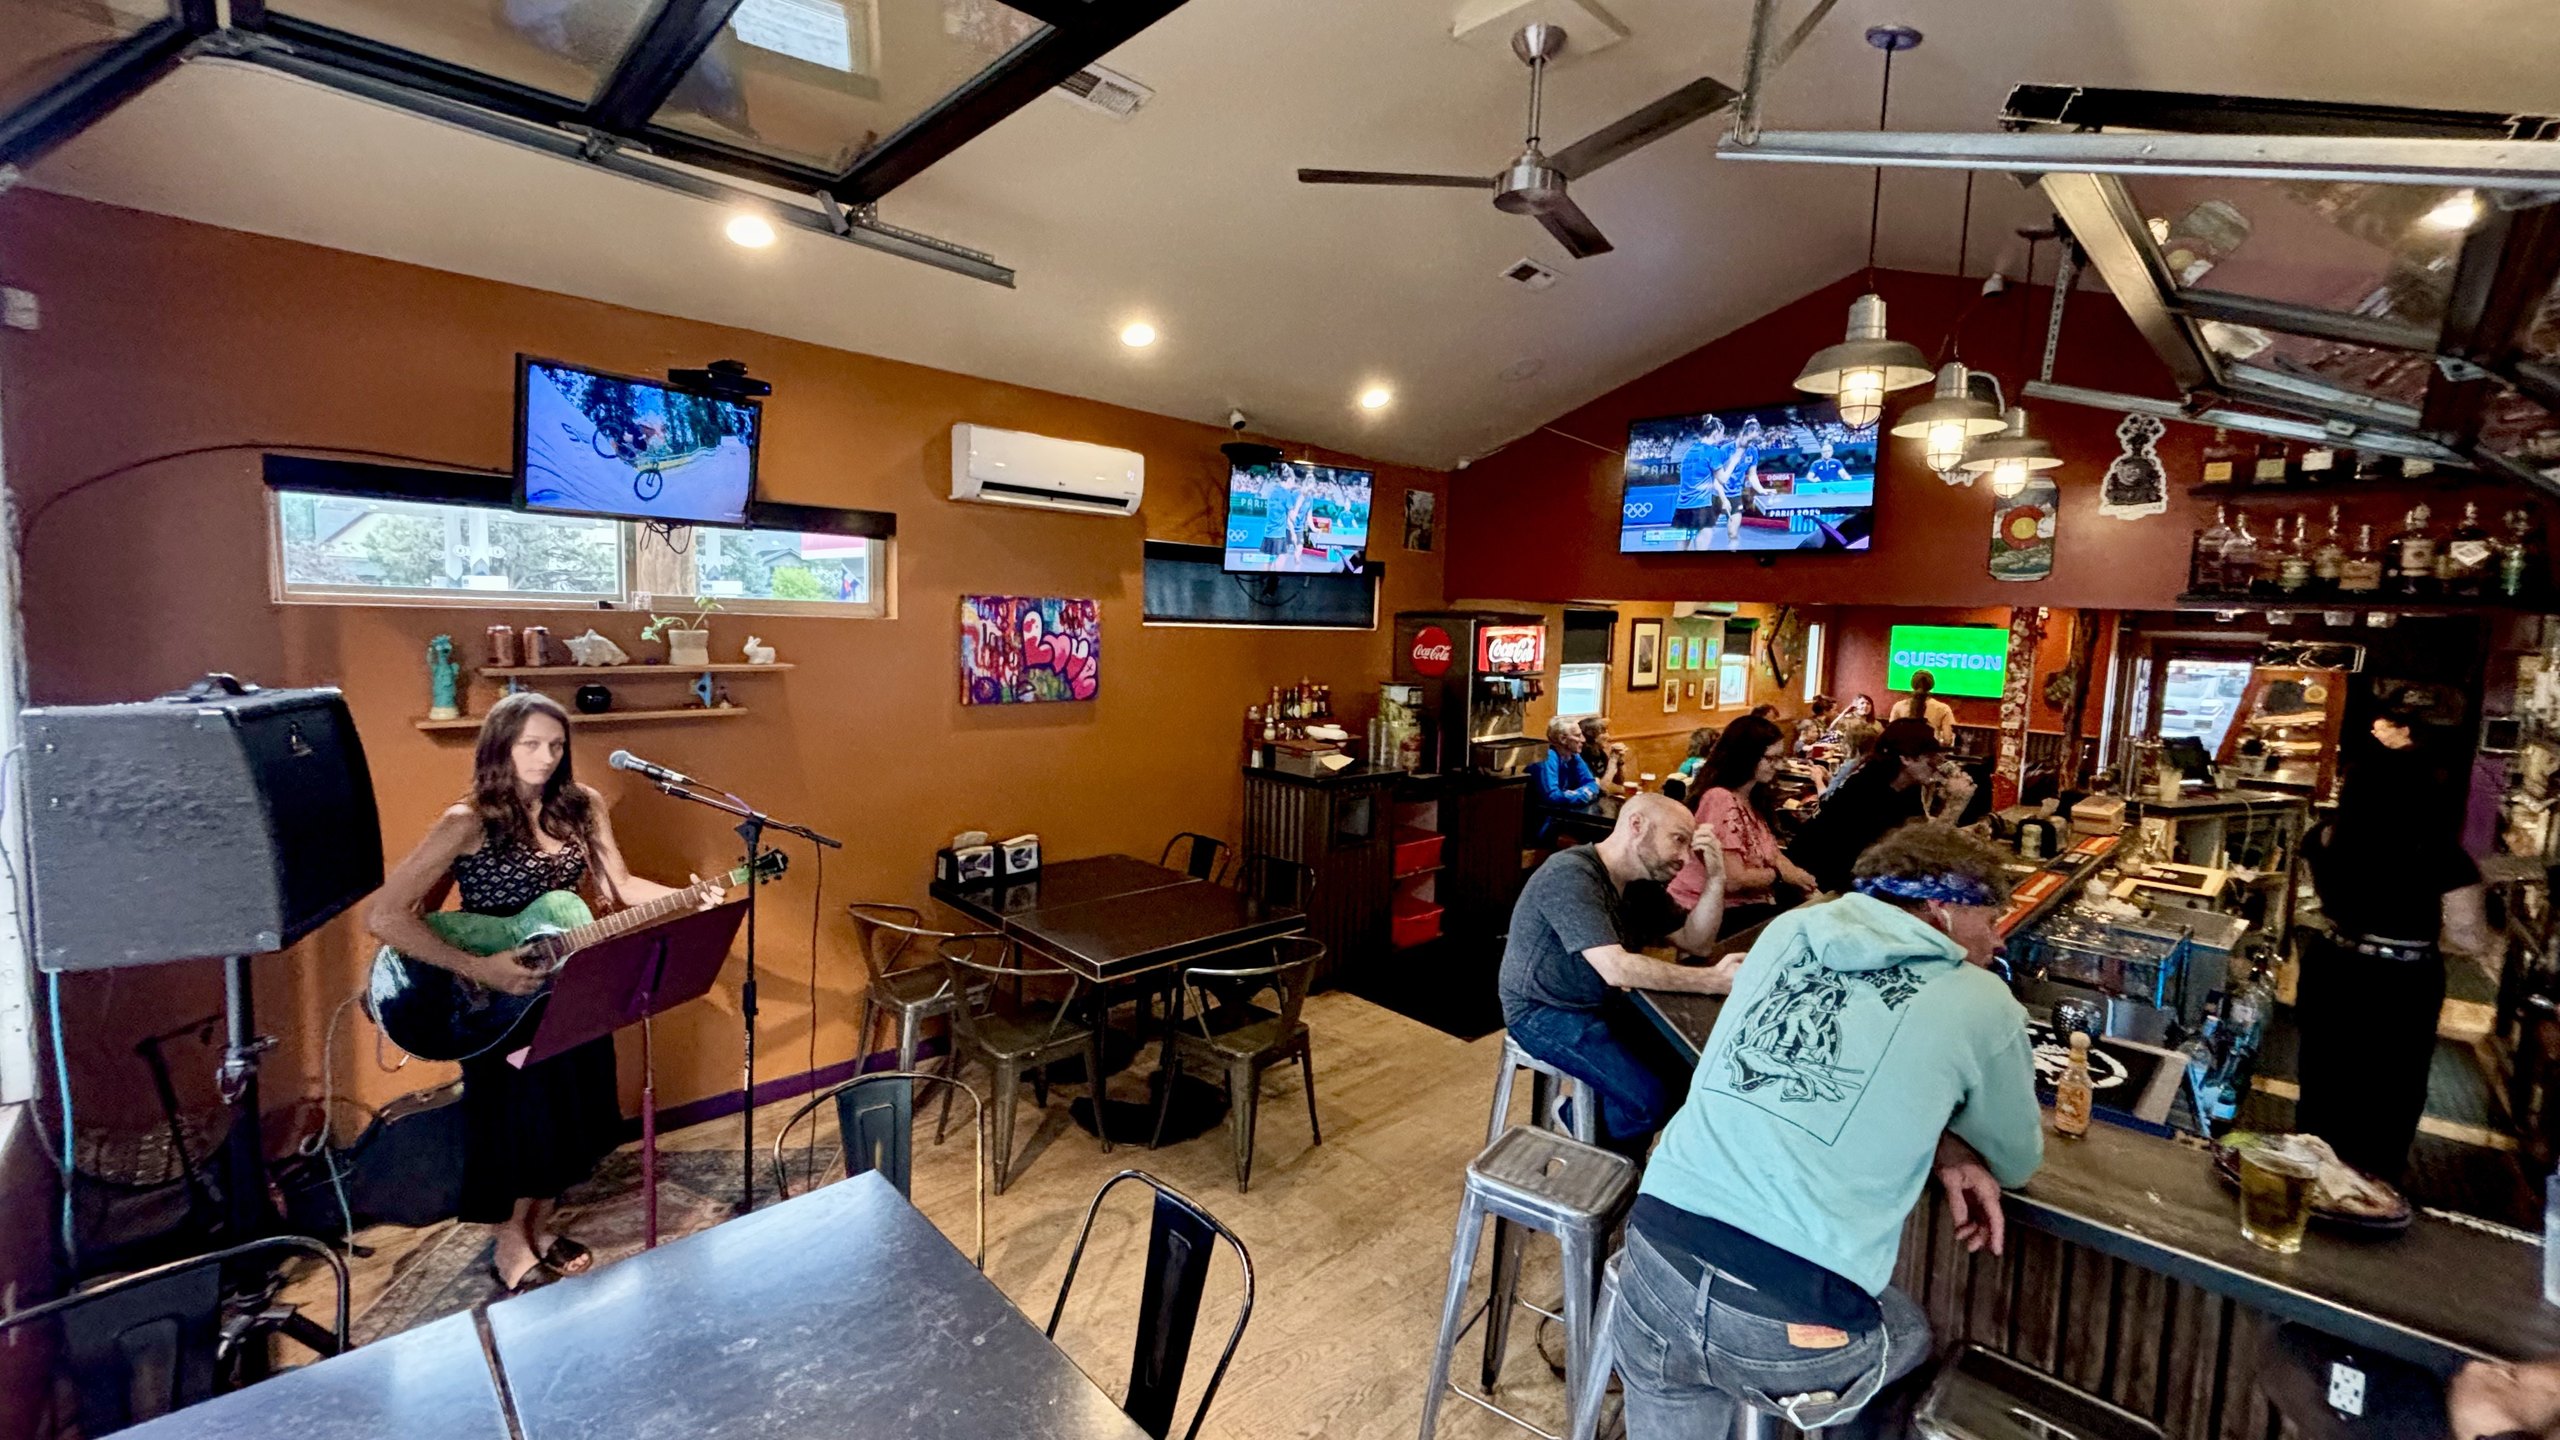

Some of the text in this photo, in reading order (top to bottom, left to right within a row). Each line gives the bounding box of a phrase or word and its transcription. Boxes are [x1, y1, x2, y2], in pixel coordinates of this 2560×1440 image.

[1412, 644, 1452, 661] Coca-Cola
[1488, 637, 1536, 664] Coca-Cola
[1894, 650, 2002, 671] QUESTION
